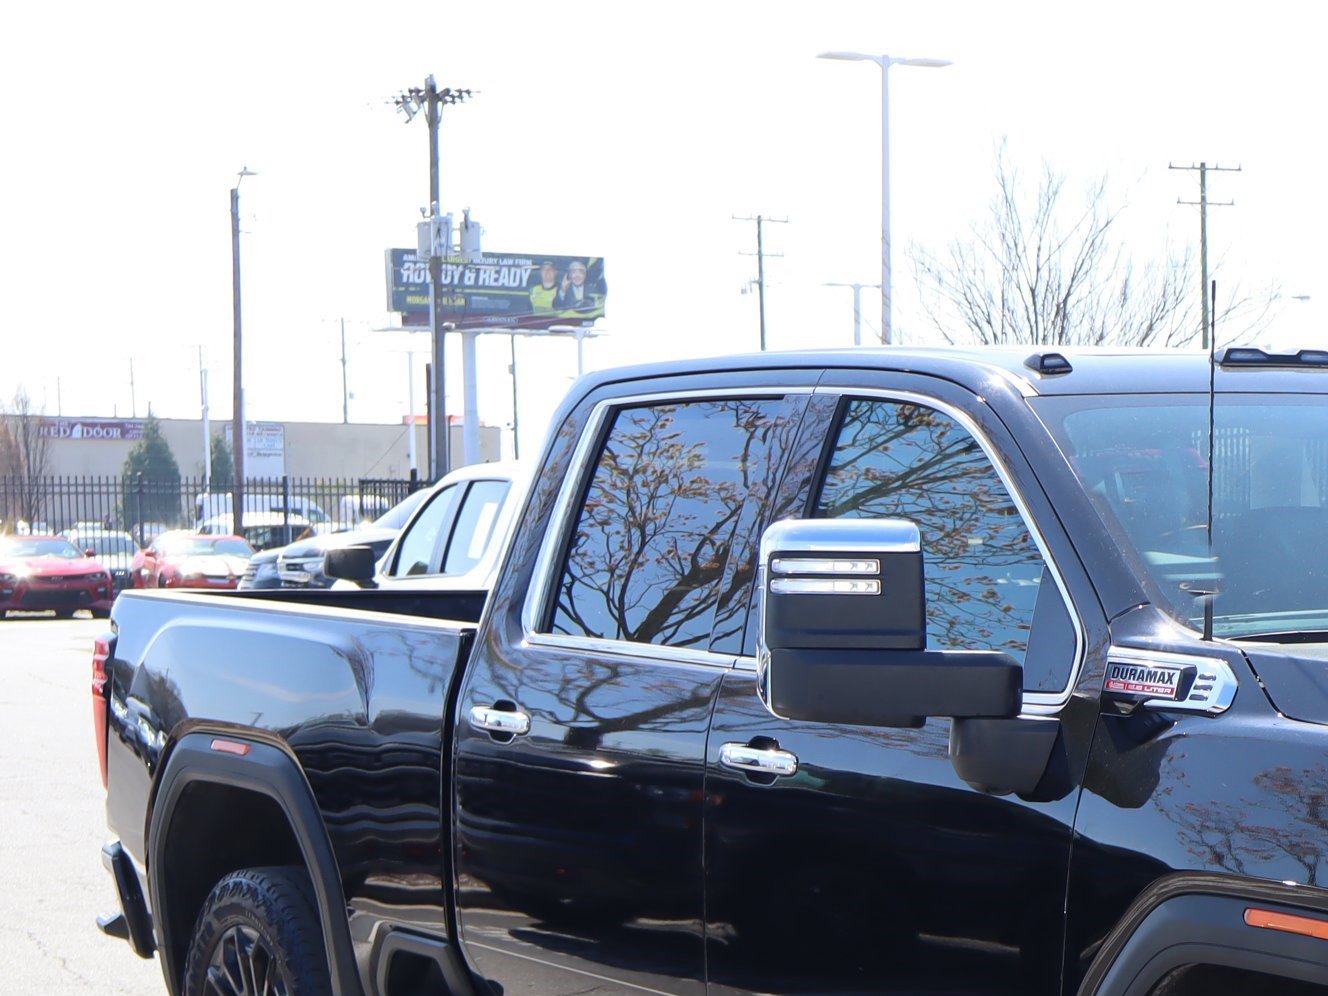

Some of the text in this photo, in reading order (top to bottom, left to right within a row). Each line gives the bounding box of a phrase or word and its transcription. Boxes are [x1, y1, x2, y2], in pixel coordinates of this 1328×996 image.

[401, 261, 463, 285] RODY
[478, 266, 532, 288] READY
[83, 426, 121, 439] DOOR
[1112, 666, 1175, 685] DURAMAX
